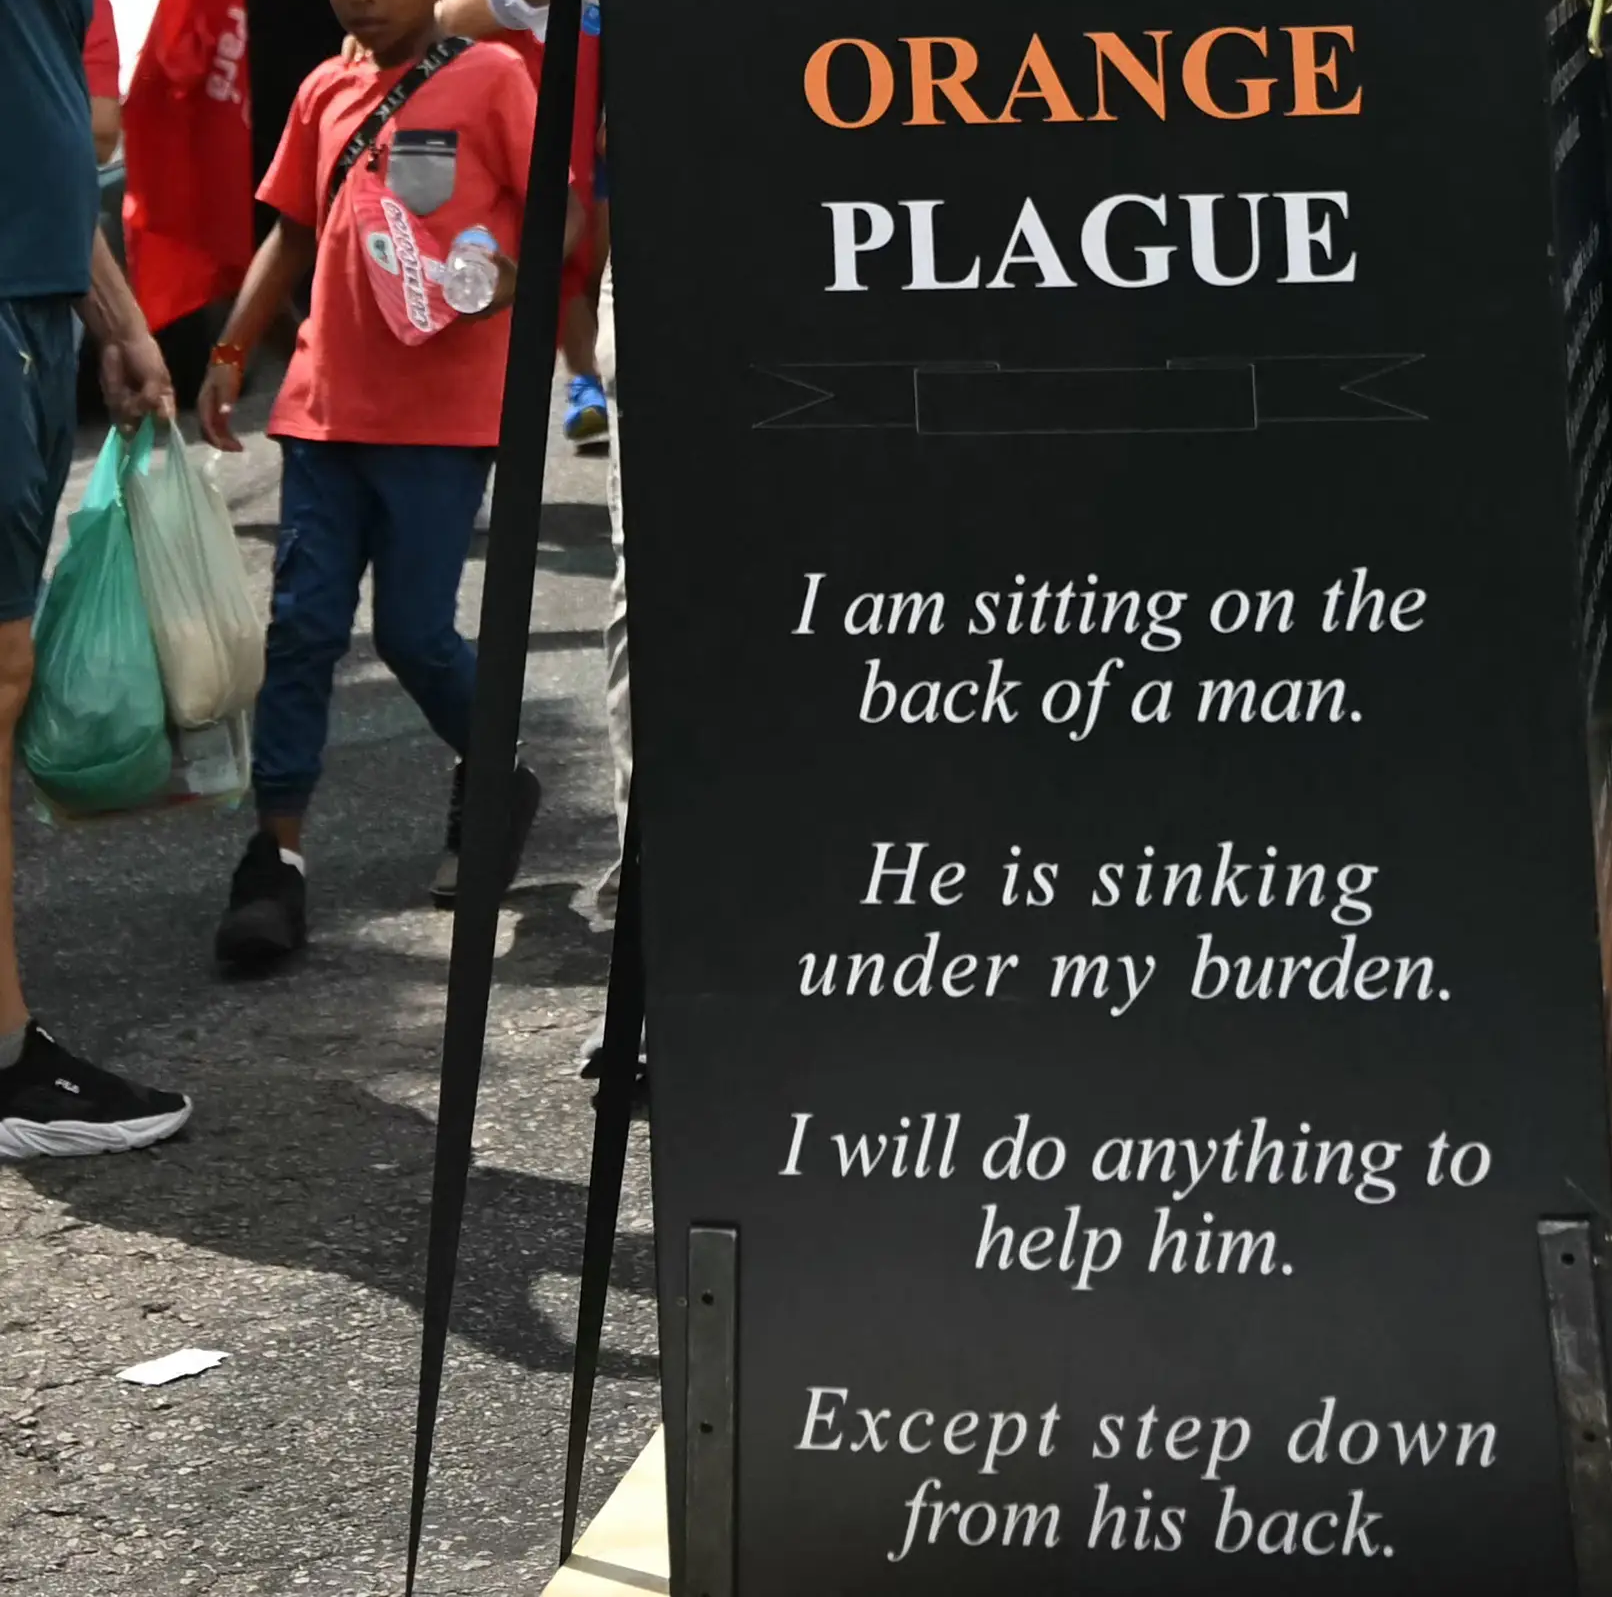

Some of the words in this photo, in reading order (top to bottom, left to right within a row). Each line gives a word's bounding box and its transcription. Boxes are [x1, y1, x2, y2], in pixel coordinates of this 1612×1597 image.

[804, 26, 1362, 128] ORANGE
[822, 191, 1356, 291] PLAGUE
[792, 573, 825, 634] I
[844, 592, 944, 634] am
[969, 573, 1187, 651] sitting
[1210, 590, 1294, 633] on
[1322, 567, 1426, 632] the
[860, 659, 1021, 723] back
[1042, 658, 1124, 741] of
[1132, 681, 1172, 723] a
[1198, 679, 1361, 722] man.
[861, 843, 965, 905] He
[1003, 845, 1058, 906] is
[1092, 841, 1378, 925] sinking
[799, 932, 1018, 997] under
[1051, 955, 1155, 1016] my
[1191, 933, 1449, 1000] burden.
[779, 1113, 812, 1175] I
[831, 1113, 960, 1178] will
[983, 1113, 1066, 1180] do
[1092, 1113, 1402, 1204] anything
[1427, 1132, 1490, 1186] to
[976, 1204, 1122, 1290] help
[1148, 1207, 1292, 1275] him.
[795, 1387, 1060, 1474] Except
[1093, 1405, 1250, 1479] step
[1288, 1396, 1495, 1467] down
[889, 1479, 1059, 1562] from
[1088, 1483, 1185, 1550] his
[1216, 1486, 1393, 1556] back.
